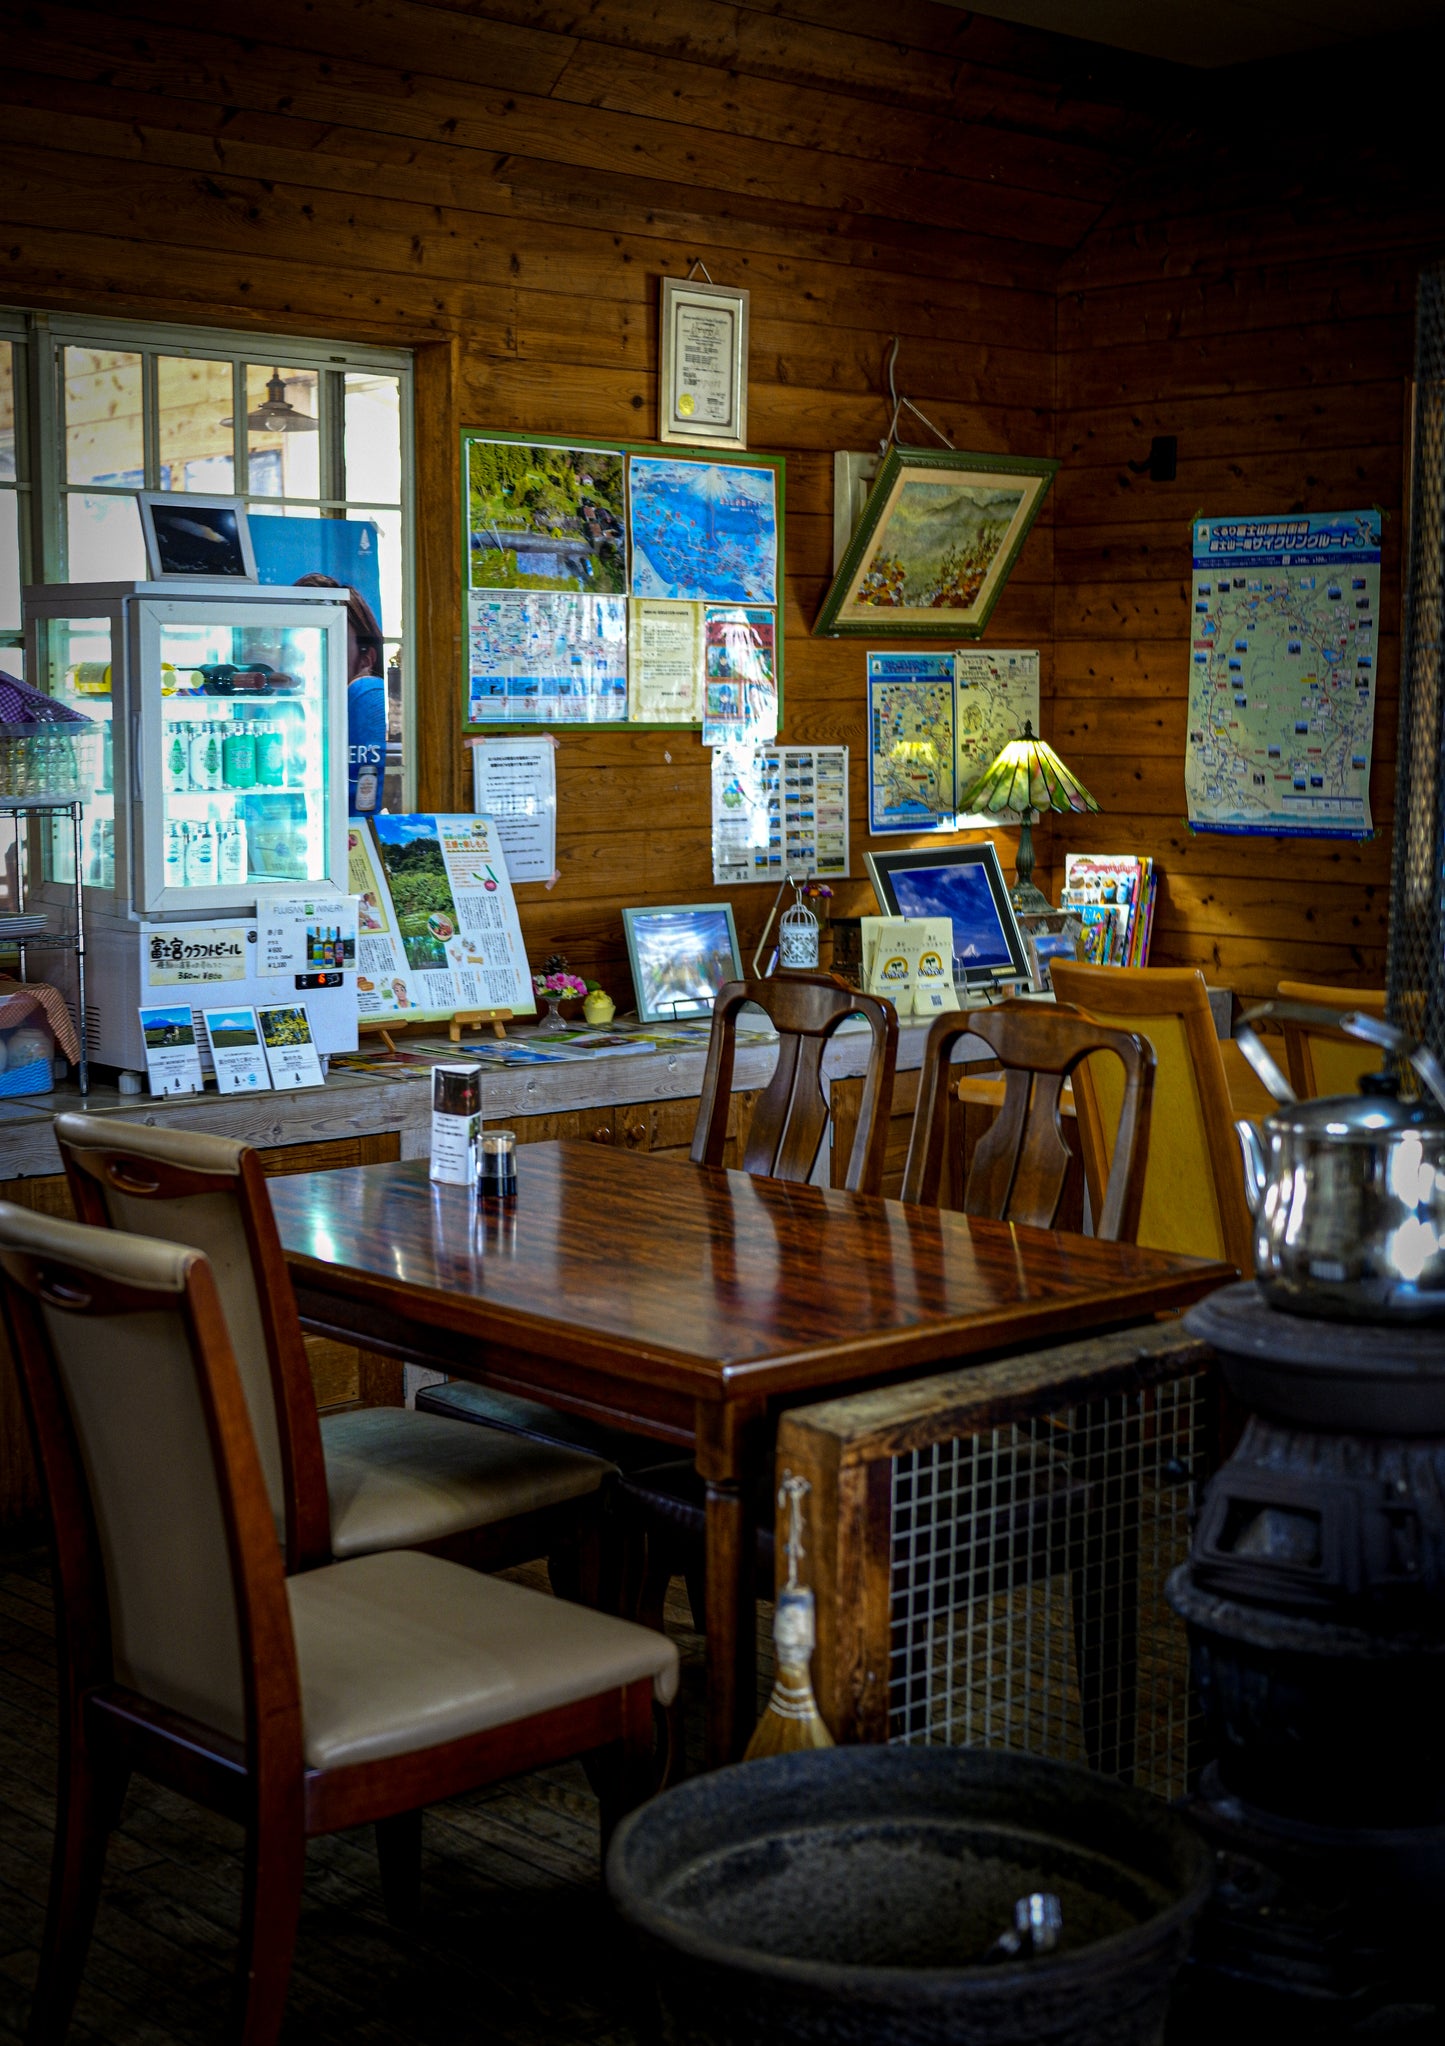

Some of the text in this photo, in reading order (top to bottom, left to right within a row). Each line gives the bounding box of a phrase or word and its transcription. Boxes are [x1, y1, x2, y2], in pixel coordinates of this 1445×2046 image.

[1210, 534, 1354, 551] 富士山一周サイクリングルート
[151, 937, 242, 959] 富士宮クラフトビール
